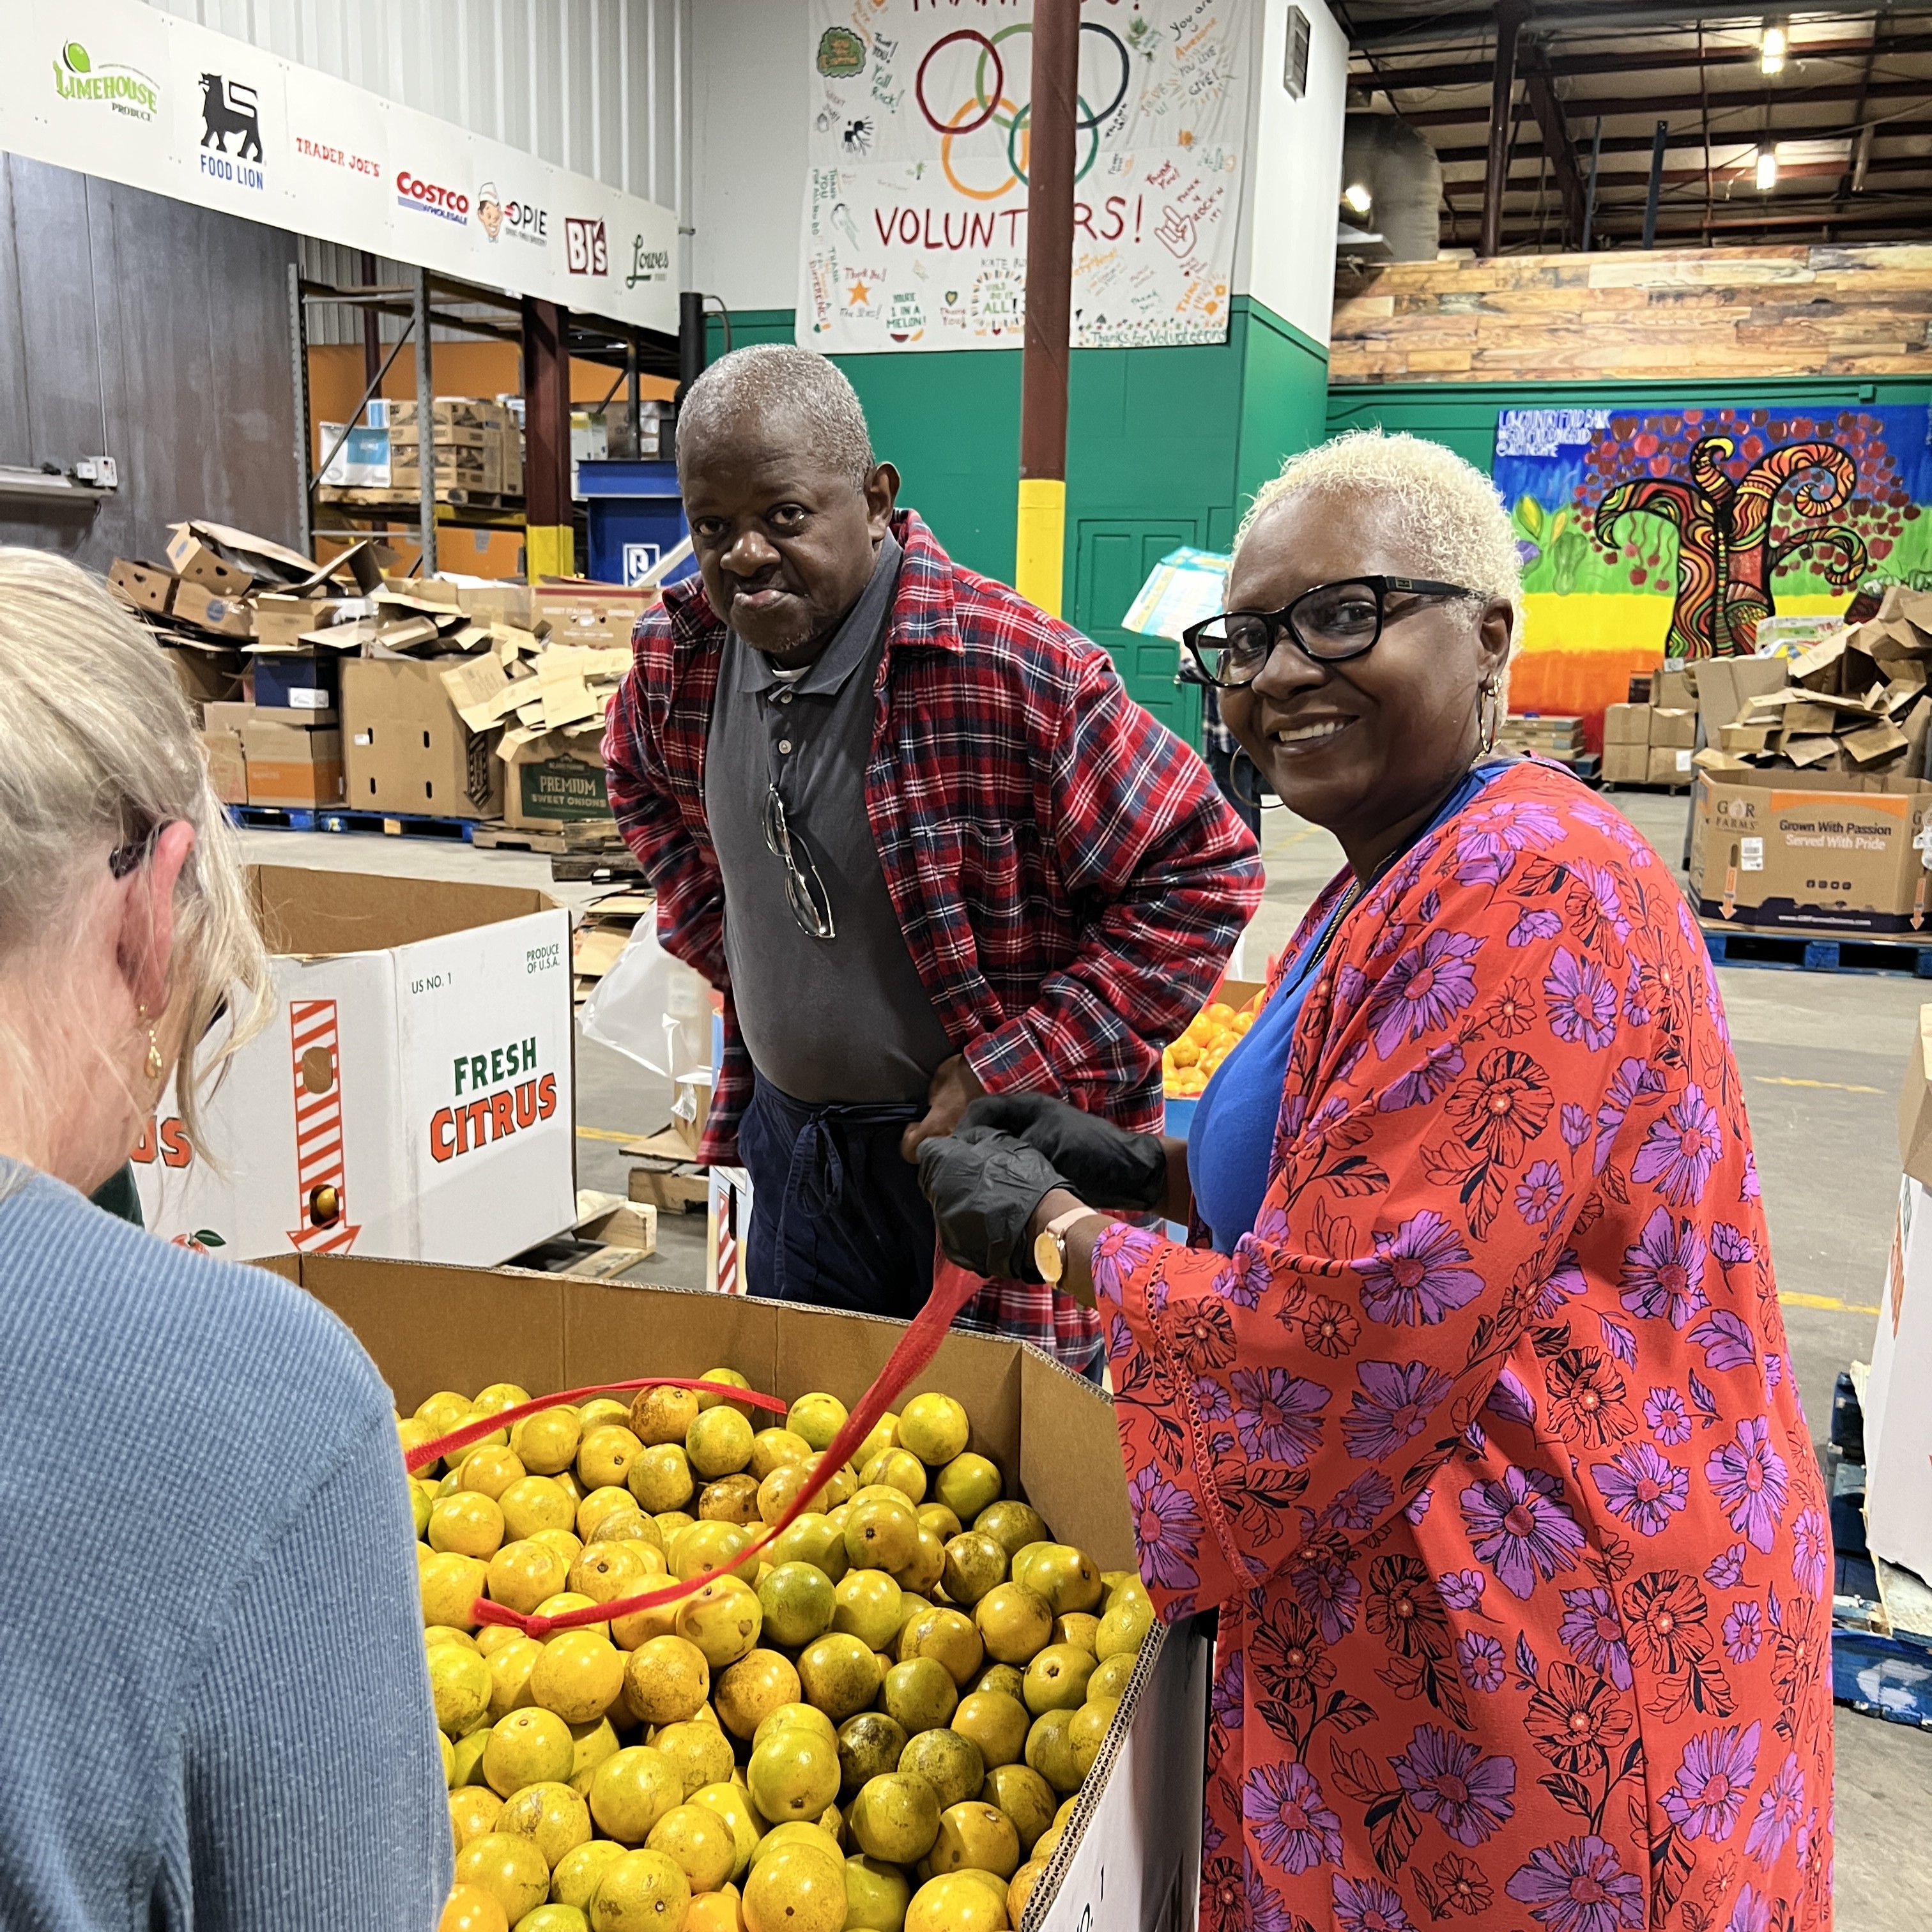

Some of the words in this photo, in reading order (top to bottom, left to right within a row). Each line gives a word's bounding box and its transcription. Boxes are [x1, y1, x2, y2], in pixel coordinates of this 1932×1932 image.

[52, 60, 157, 114] LIMEHOUSE
[111, 102, 152, 123] PRODUCE
[296, 137, 344, 166] TRADER
[348, 155, 380, 178] JOE'S
[201, 154, 233, 181] FOOD
[237, 165, 263, 190] LION
[397, 171, 469, 213] COSTCO
[423, 203, 468, 226] WHOLESALE
[509, 201, 548, 236] OPIE
[874, 194, 1143, 250] VOLUNTRS!
[540, 776, 595, 797] PREMIUM
[532, 793, 565, 805] SWEET
[567, 797, 606, 808] ONIONS
[1716, 816, 1756, 831] FARMS
[1779, 820, 1815, 832] Grown
[1818, 821, 1843, 833] With
[1846, 822, 1892, 836] Passion
[1786, 833, 1825, 847] Served
[1827, 836, 1853, 848] With
[1855, 836, 1885, 850] Pride
[526, 943, 559, 962] PRODUCE
[527, 962, 537, 974] OF
[539, 957, 560, 971] U.S.A.
[411, 981, 424, 994] US
[427, 976, 445, 990] NO.
[448, 972, 452, 985] 1
[454, 1036, 537, 1096] FRESH
[430, 1073, 557, 1163] CITRUS
